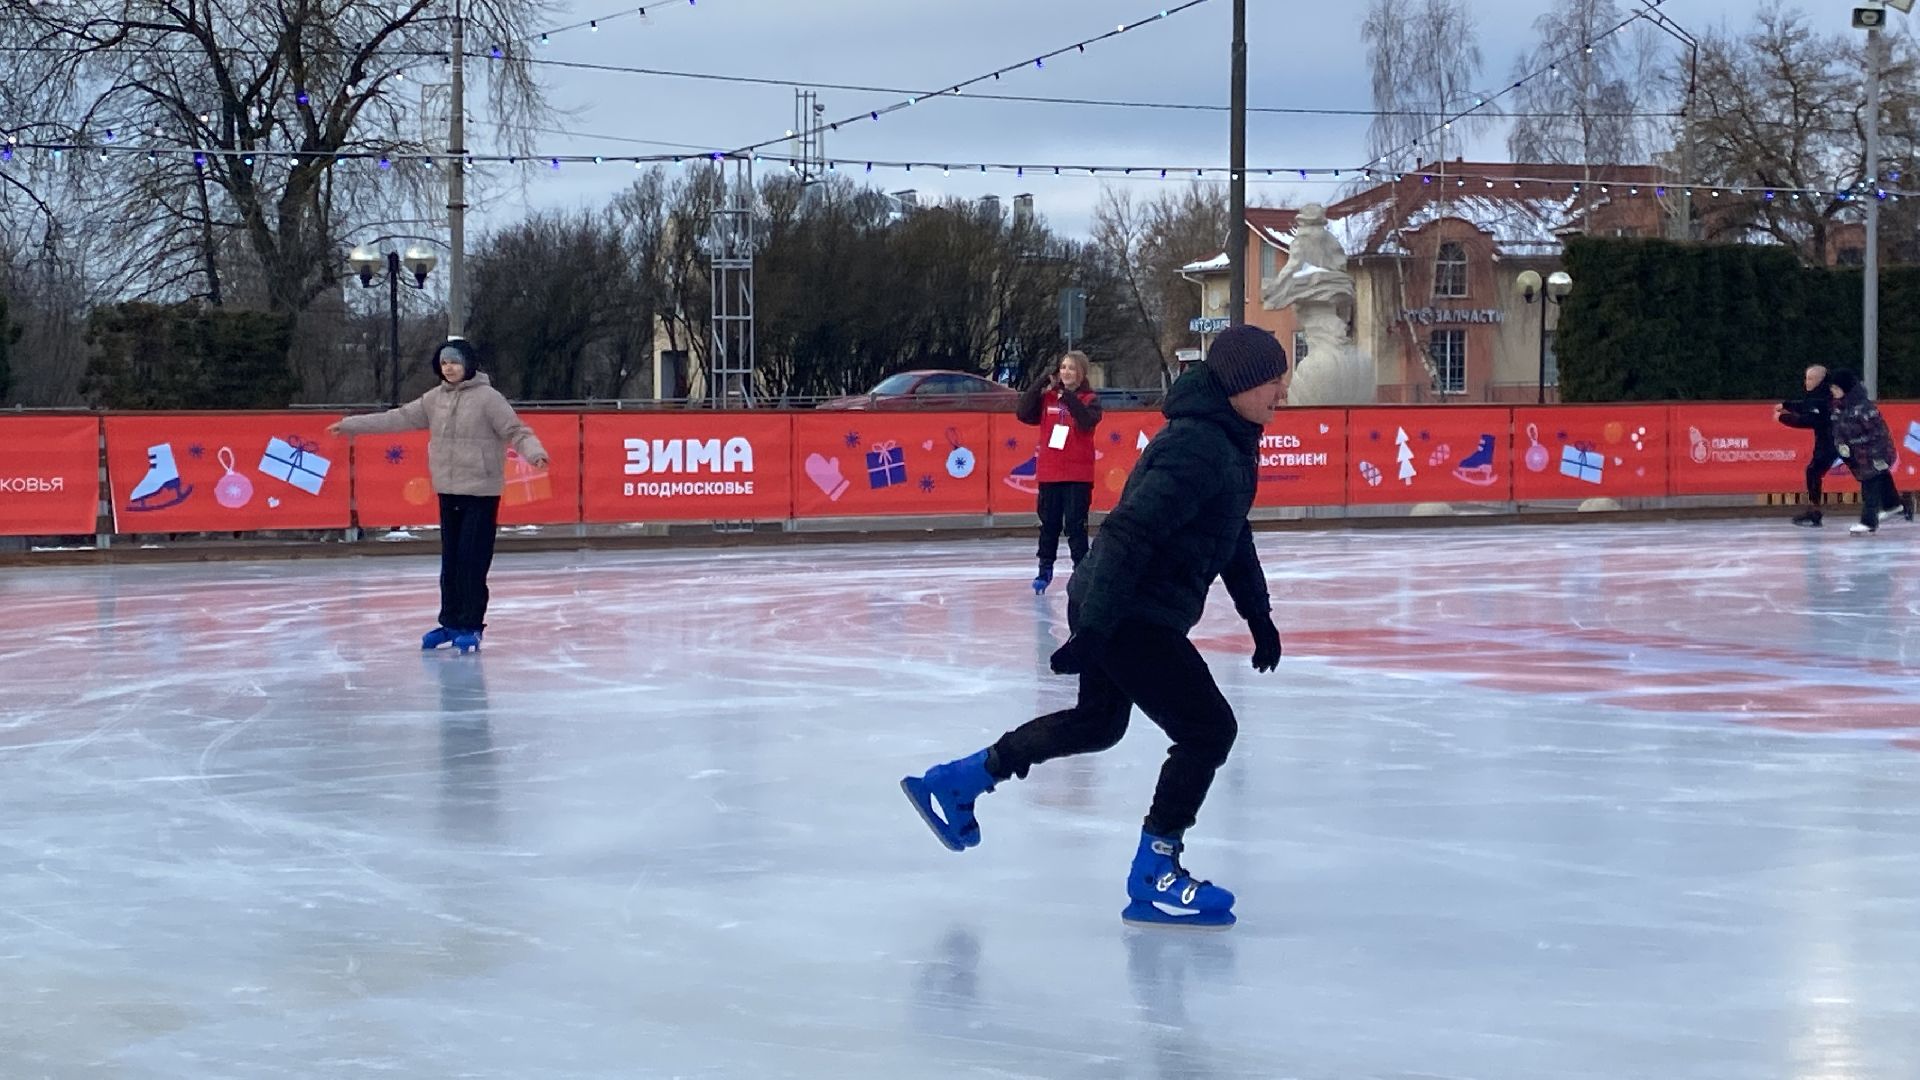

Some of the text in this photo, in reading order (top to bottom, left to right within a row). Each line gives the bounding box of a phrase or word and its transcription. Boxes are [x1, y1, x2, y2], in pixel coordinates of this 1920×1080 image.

[624, 437, 754, 474] ЗИМА
[0, 477, 64, 493] КОВЬЯ
[624, 481, 754, 498] В ПОДМОСКОВЬЕ
